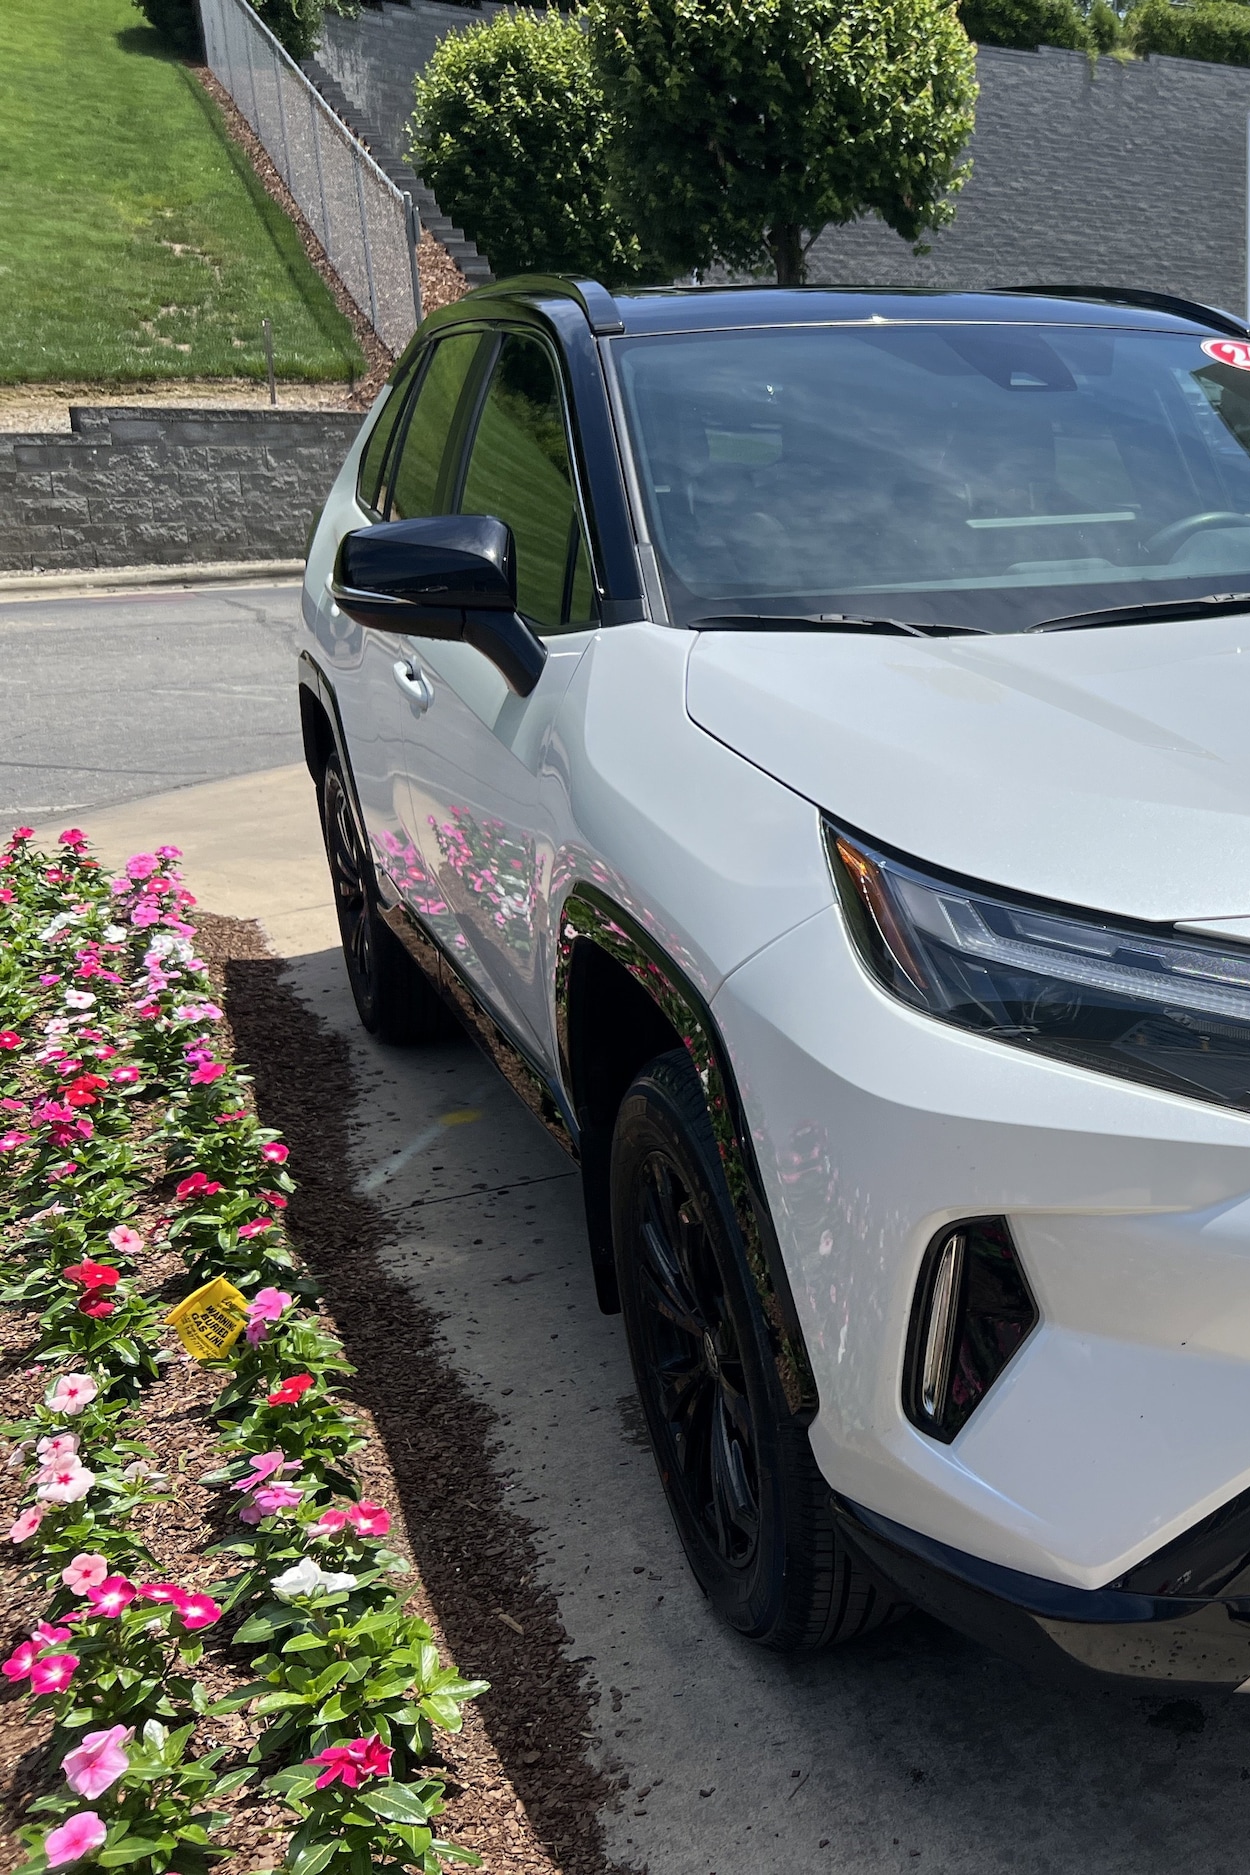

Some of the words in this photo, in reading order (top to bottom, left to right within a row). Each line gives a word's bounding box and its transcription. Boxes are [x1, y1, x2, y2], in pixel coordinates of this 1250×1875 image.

[191, 1312, 207, 1332] GAS
[204, 1331, 225, 1348] LINE
[200, 1312, 229, 1339] BURIED
[205, 1305, 237, 1332] WARNING
